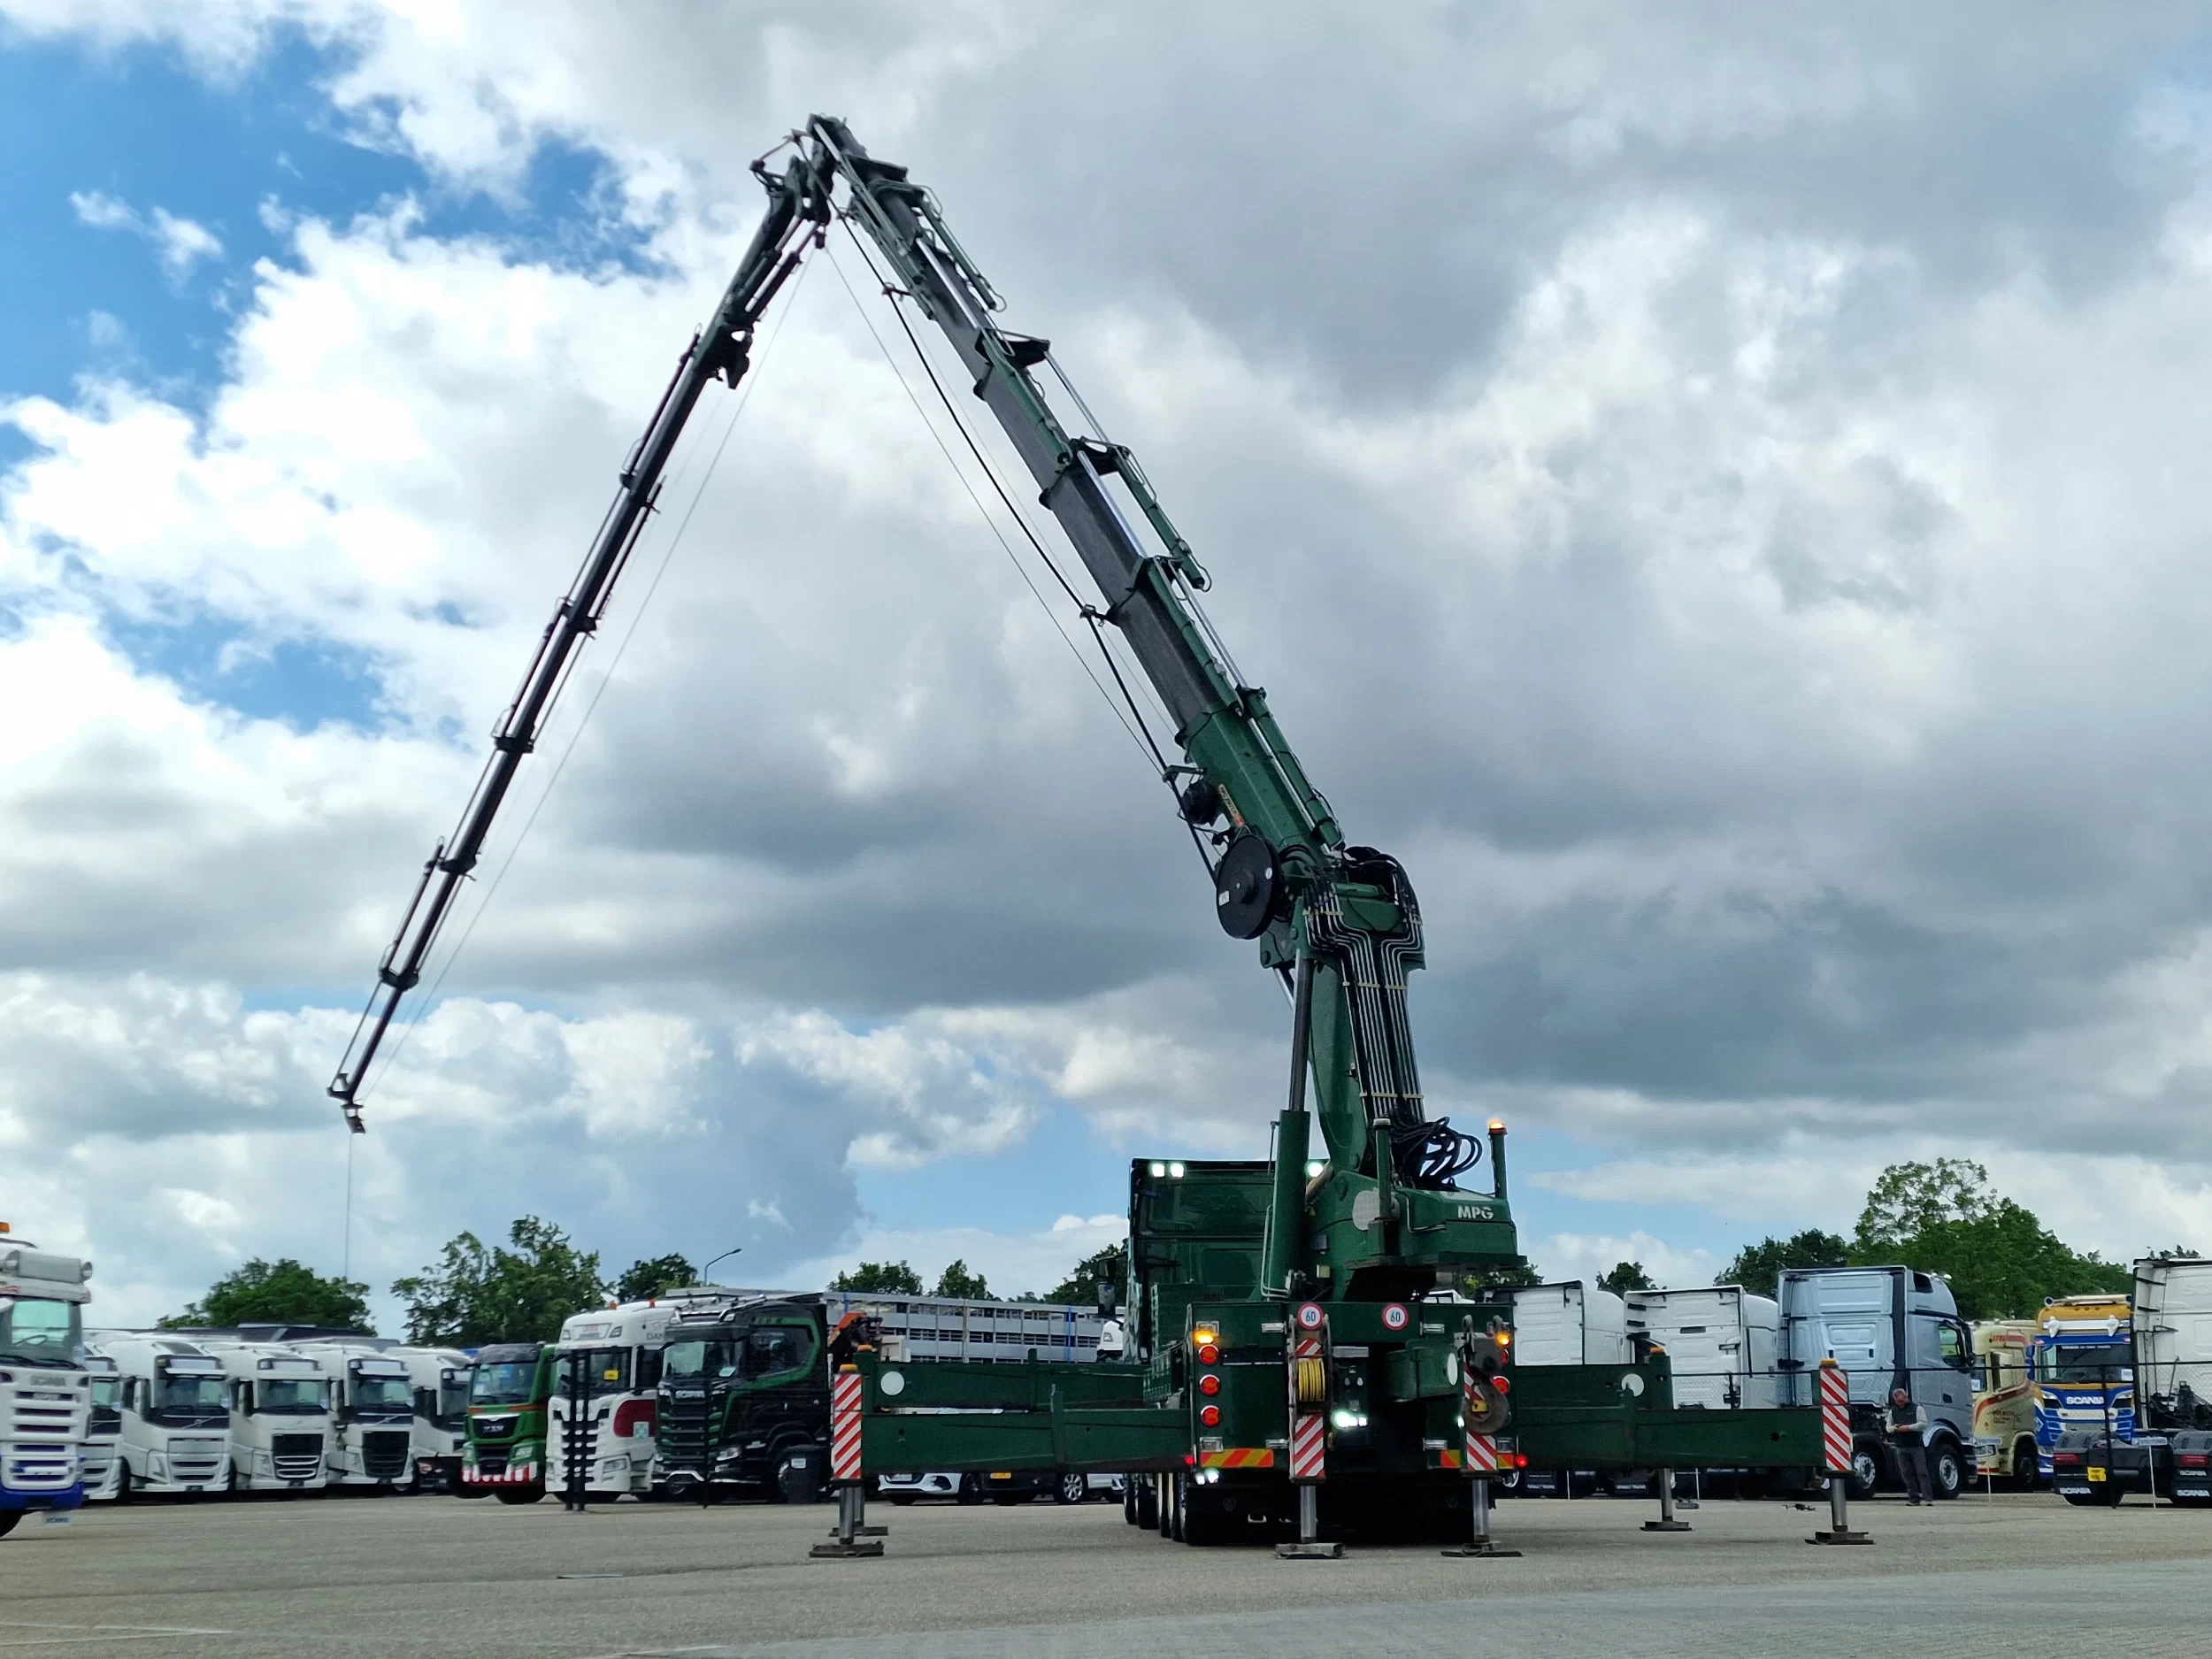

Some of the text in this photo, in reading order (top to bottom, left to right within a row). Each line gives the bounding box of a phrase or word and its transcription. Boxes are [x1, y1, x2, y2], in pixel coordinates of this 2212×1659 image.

[1457, 1204, 1494, 1220] MPG
[1305, 1311, 1317, 1322] 60
[1390, 1311, 1401, 1323] 60
[2066, 1396, 2105, 1405] SCANIA
